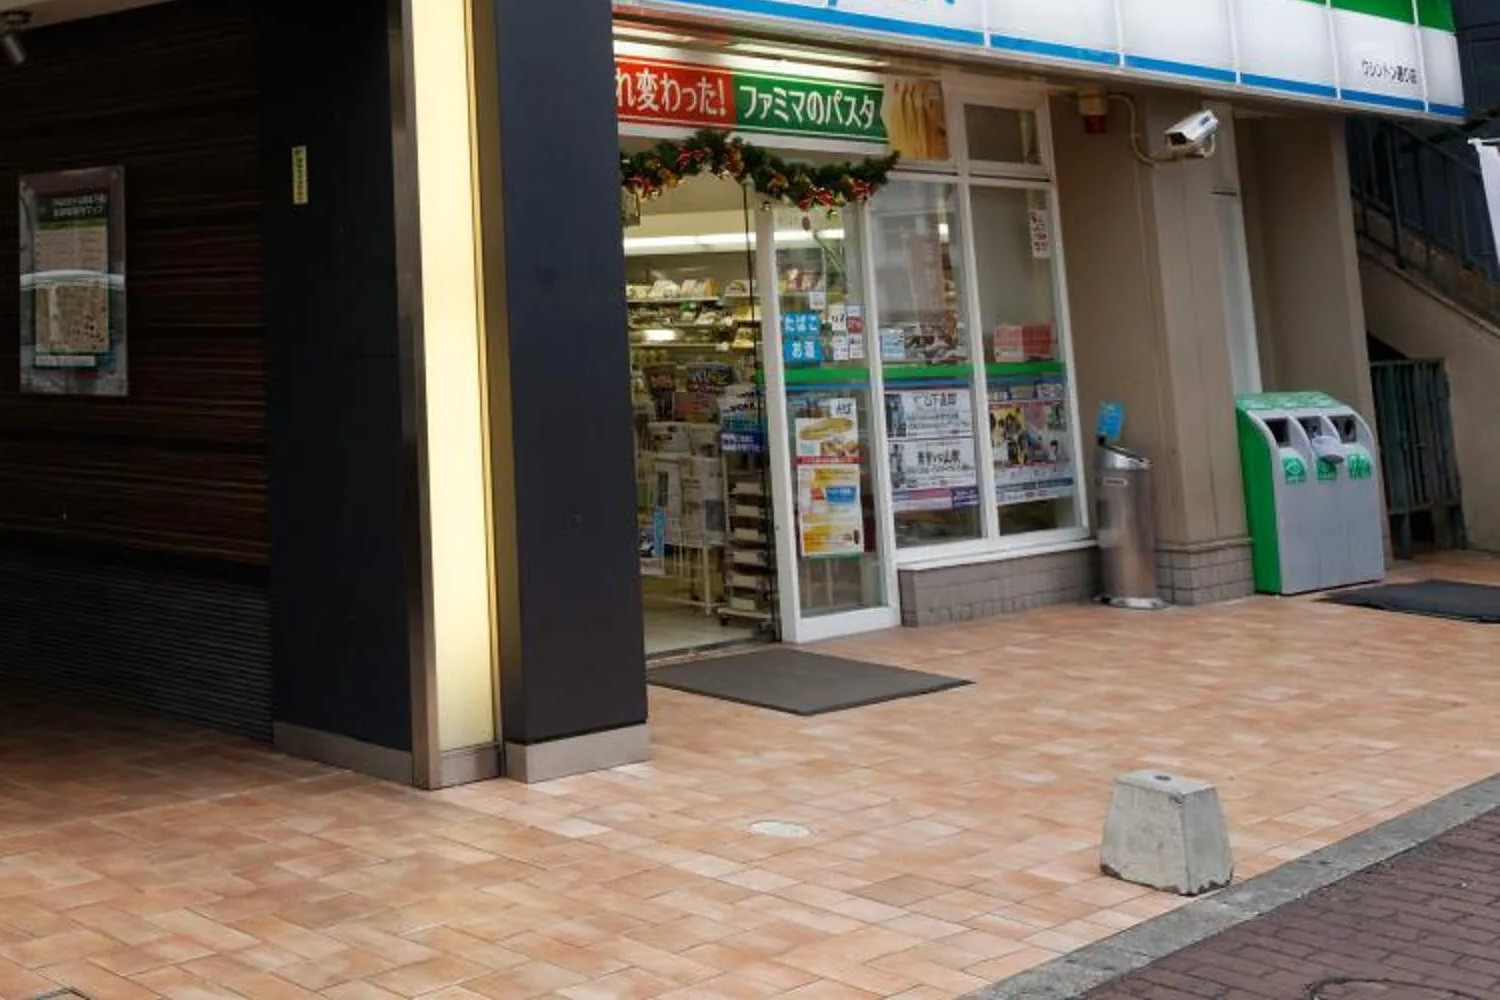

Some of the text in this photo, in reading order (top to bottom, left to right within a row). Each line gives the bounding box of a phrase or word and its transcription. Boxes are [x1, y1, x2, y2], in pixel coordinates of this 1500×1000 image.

[739, 84, 876, 129] ファミマのパスタ
[784, 313, 818, 332] たばこ
